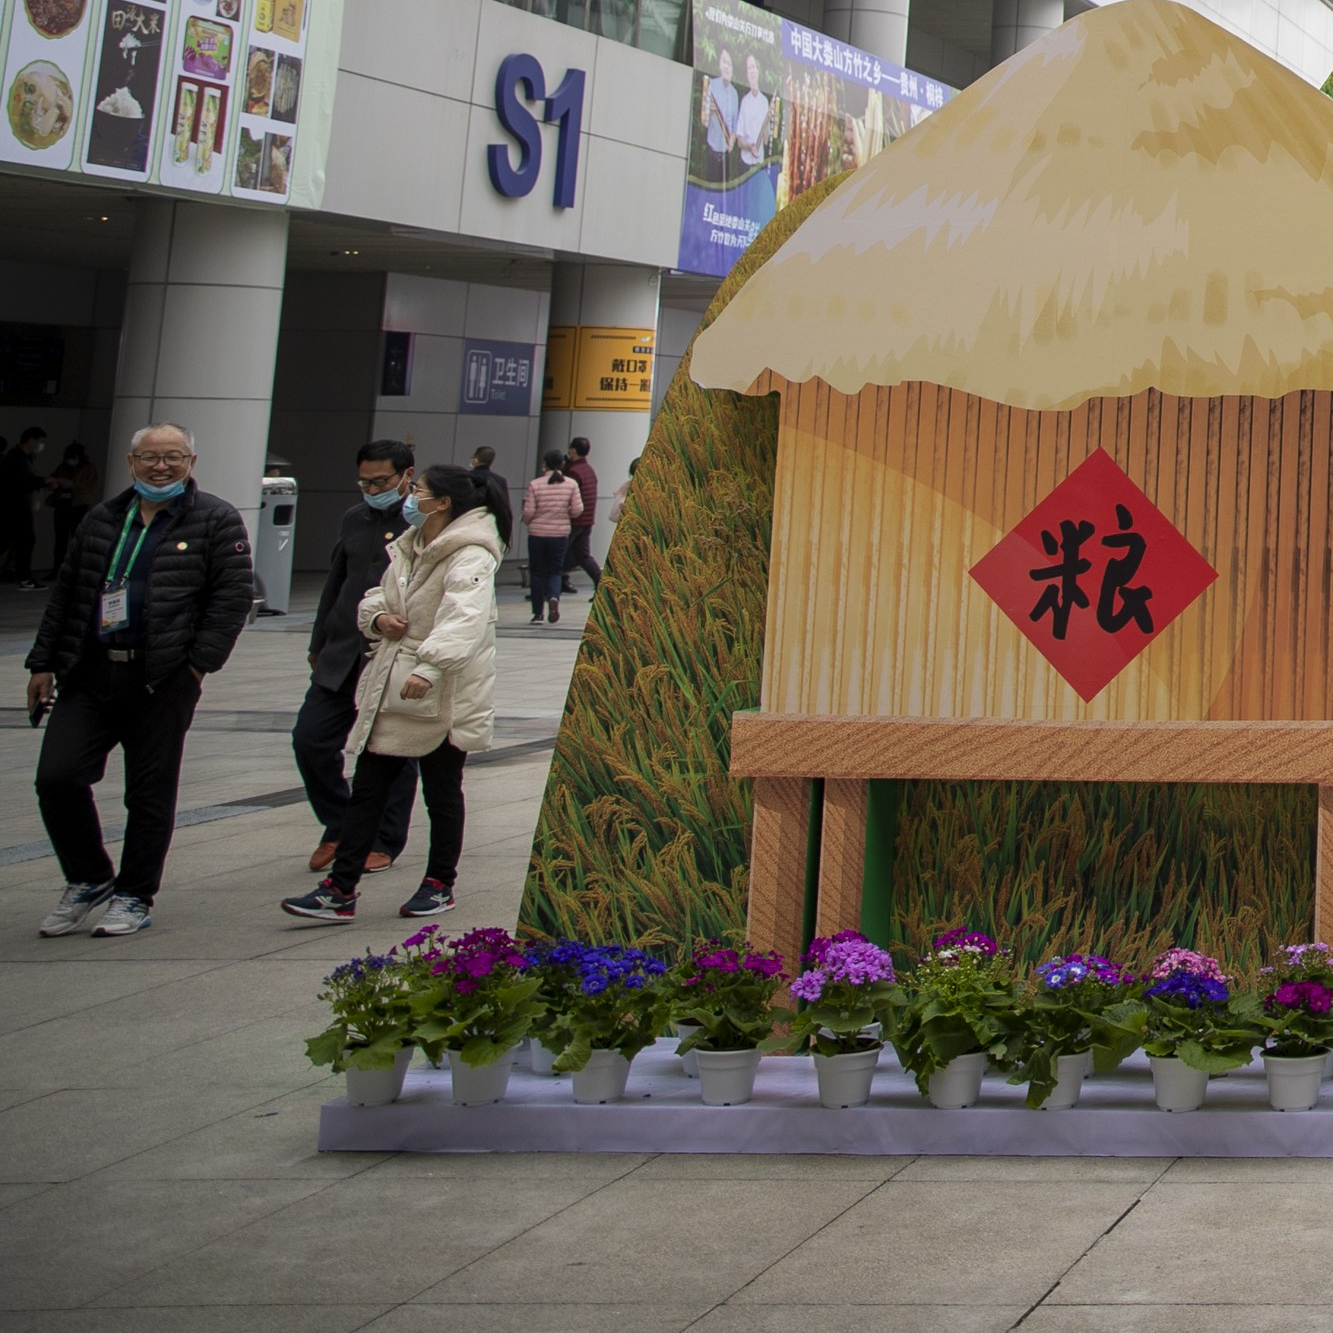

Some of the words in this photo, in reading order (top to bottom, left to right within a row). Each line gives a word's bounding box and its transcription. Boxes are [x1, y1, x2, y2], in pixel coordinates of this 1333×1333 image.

[488, 53, 586, 209] S1
[492, 357, 530, 388] 卫生间
[1027, 504, 1154, 641] 粮
